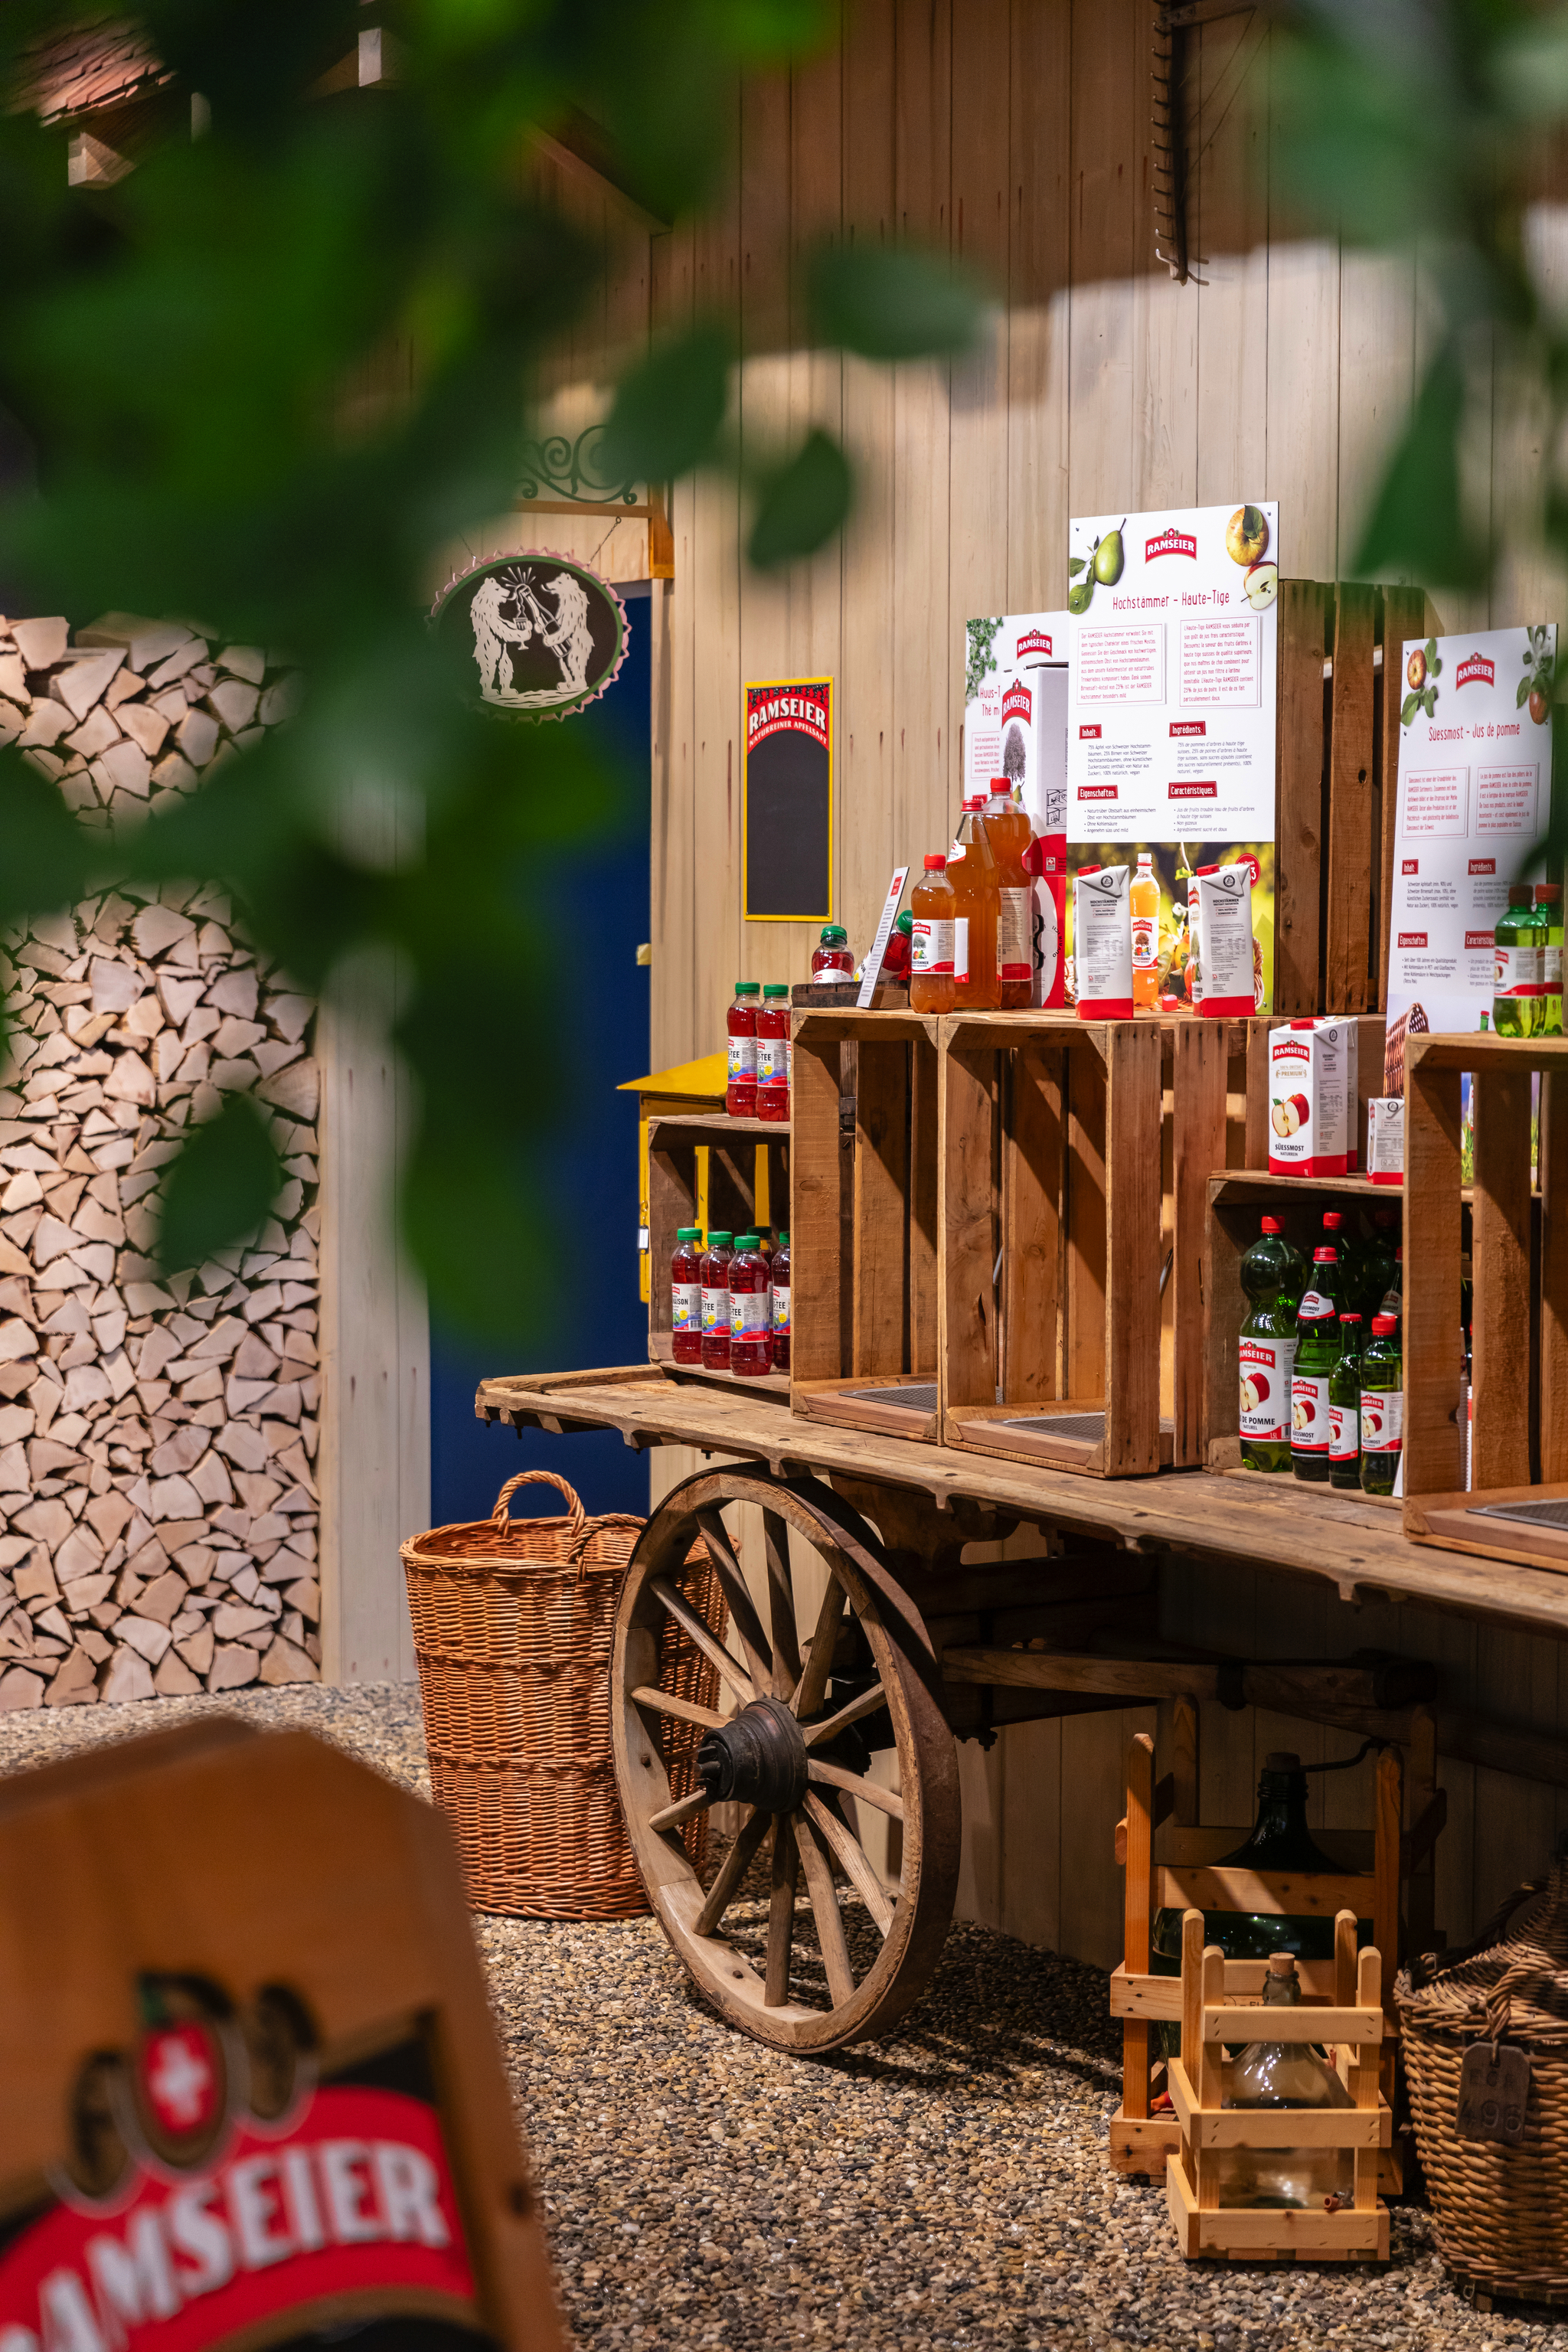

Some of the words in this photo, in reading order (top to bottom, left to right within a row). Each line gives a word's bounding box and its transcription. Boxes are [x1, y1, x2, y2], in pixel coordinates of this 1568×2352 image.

[1147, 539, 1195, 555] RAMSEIER
[1112, 596, 1170, 610] Hochstämmer
[1181, 590, 1230, 608] Haute-Tige
[1018, 639, 1051, 654] RAMSEIER
[1457, 664, 1494, 682] RAMSEIER
[982, 704, 991, 717] Thé
[1003, 695, 1031, 717] RAMSEIER
[749, 697, 827, 737] RAMSEIER
[749, 720, 792, 747] NATURREINER
[794, 721, 828, 745] APFELSAFT
[1082, 728, 1098, 737] Inhalt:
[1172, 725, 1203, 736] Ingrédients:
[1429, 725, 1464, 741] Süessmost
[1472, 724, 1485, 739] Jus
[1487, 722, 1494, 737] de
[1497, 723, 1521, 739] pomme
[1080, 788, 1116, 799] Eigenschaften:
[1171, 786, 1215, 796] Caractéristiques:
[1274, 1047, 1308, 1057] RAMSEIER
[1275, 1143, 1304, 1152] SÜESSMOST
[0, 2137, 451, 2352] AMSEIER
